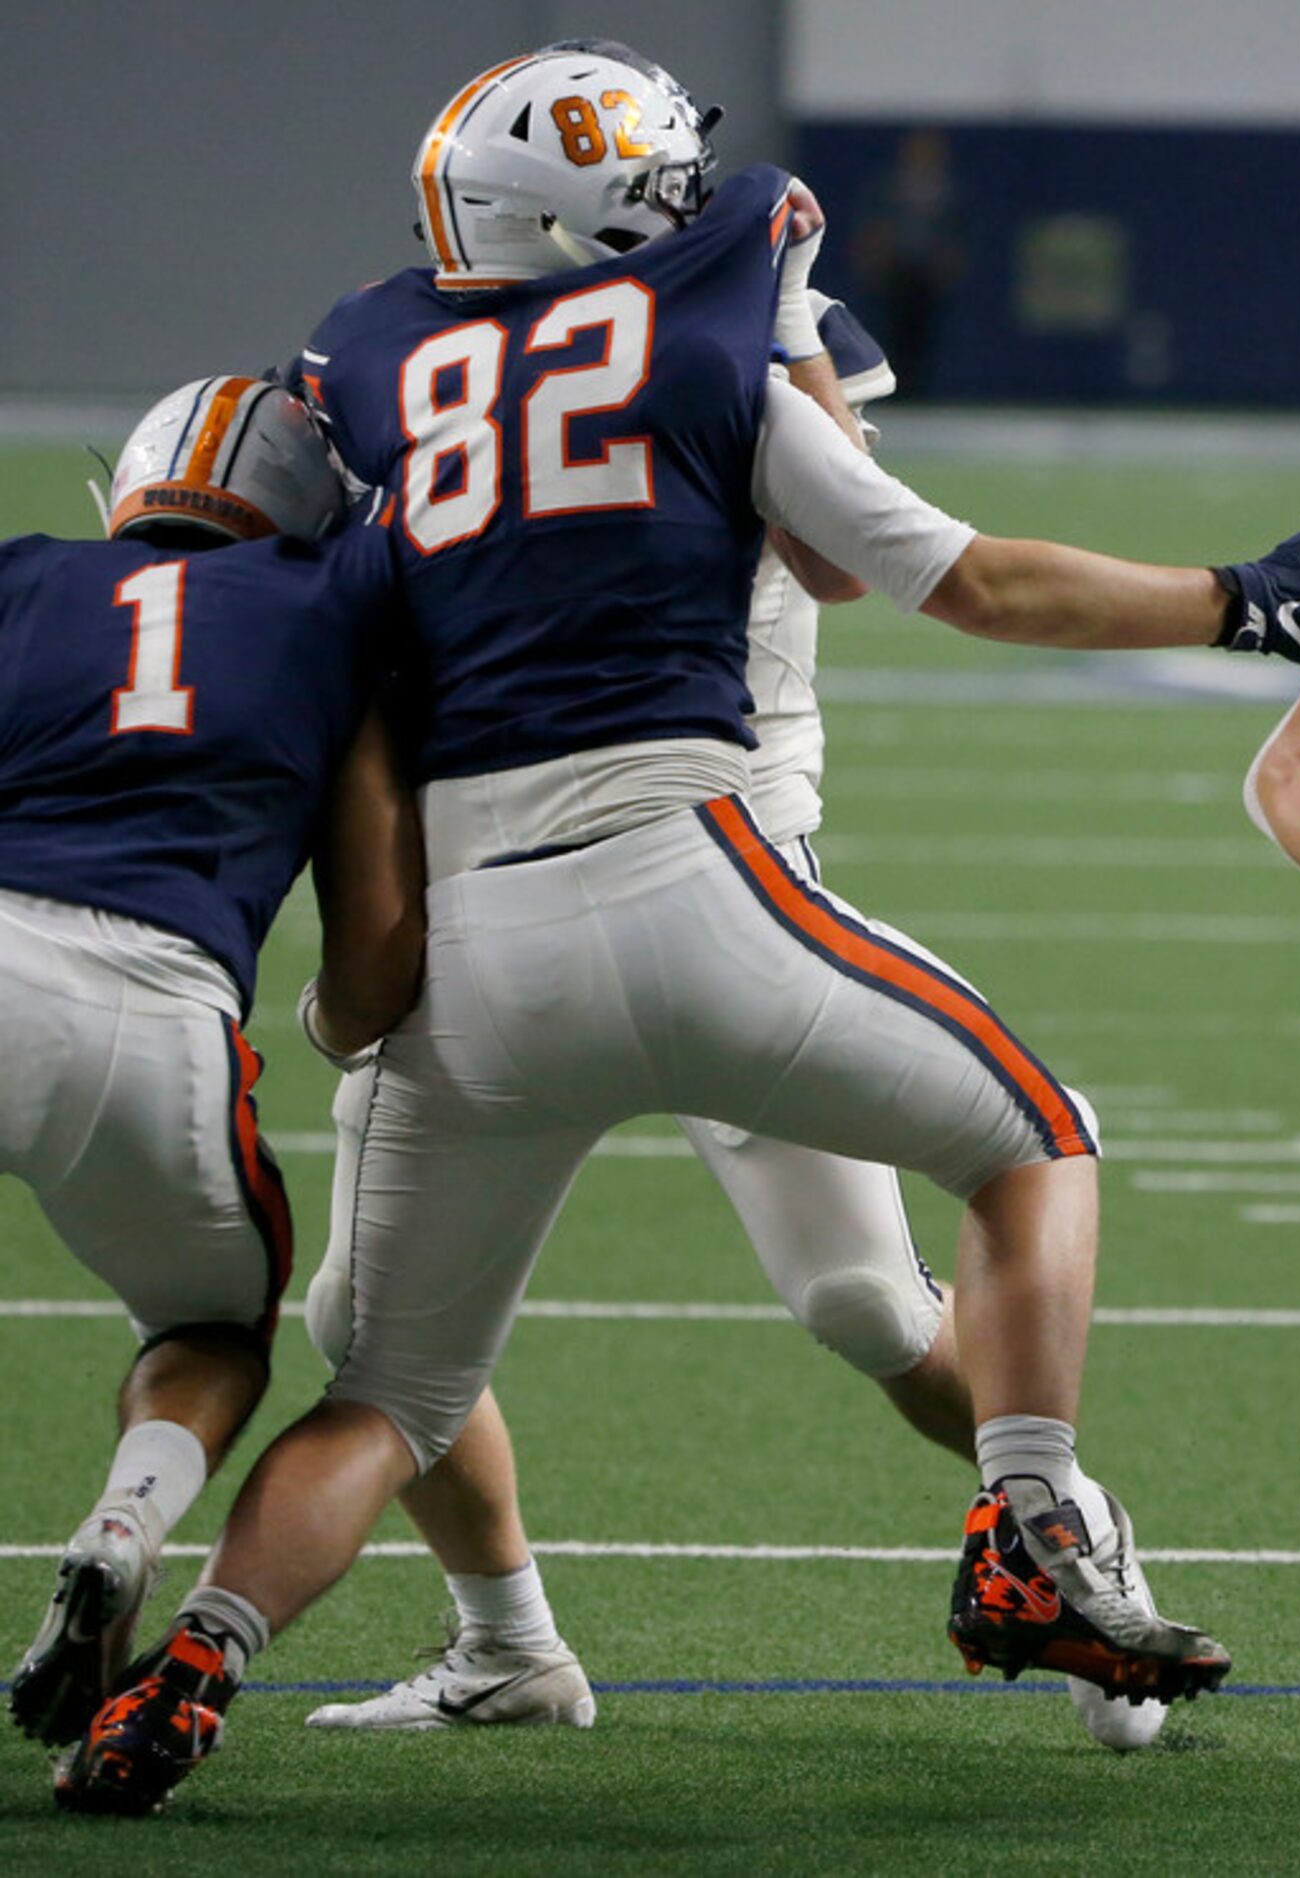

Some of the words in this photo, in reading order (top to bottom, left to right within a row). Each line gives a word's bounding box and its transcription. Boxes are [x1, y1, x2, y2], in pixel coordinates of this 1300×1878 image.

[550, 89, 653, 167] 82
[398, 275, 655, 556] 82
[109, 559, 194, 735] 1
